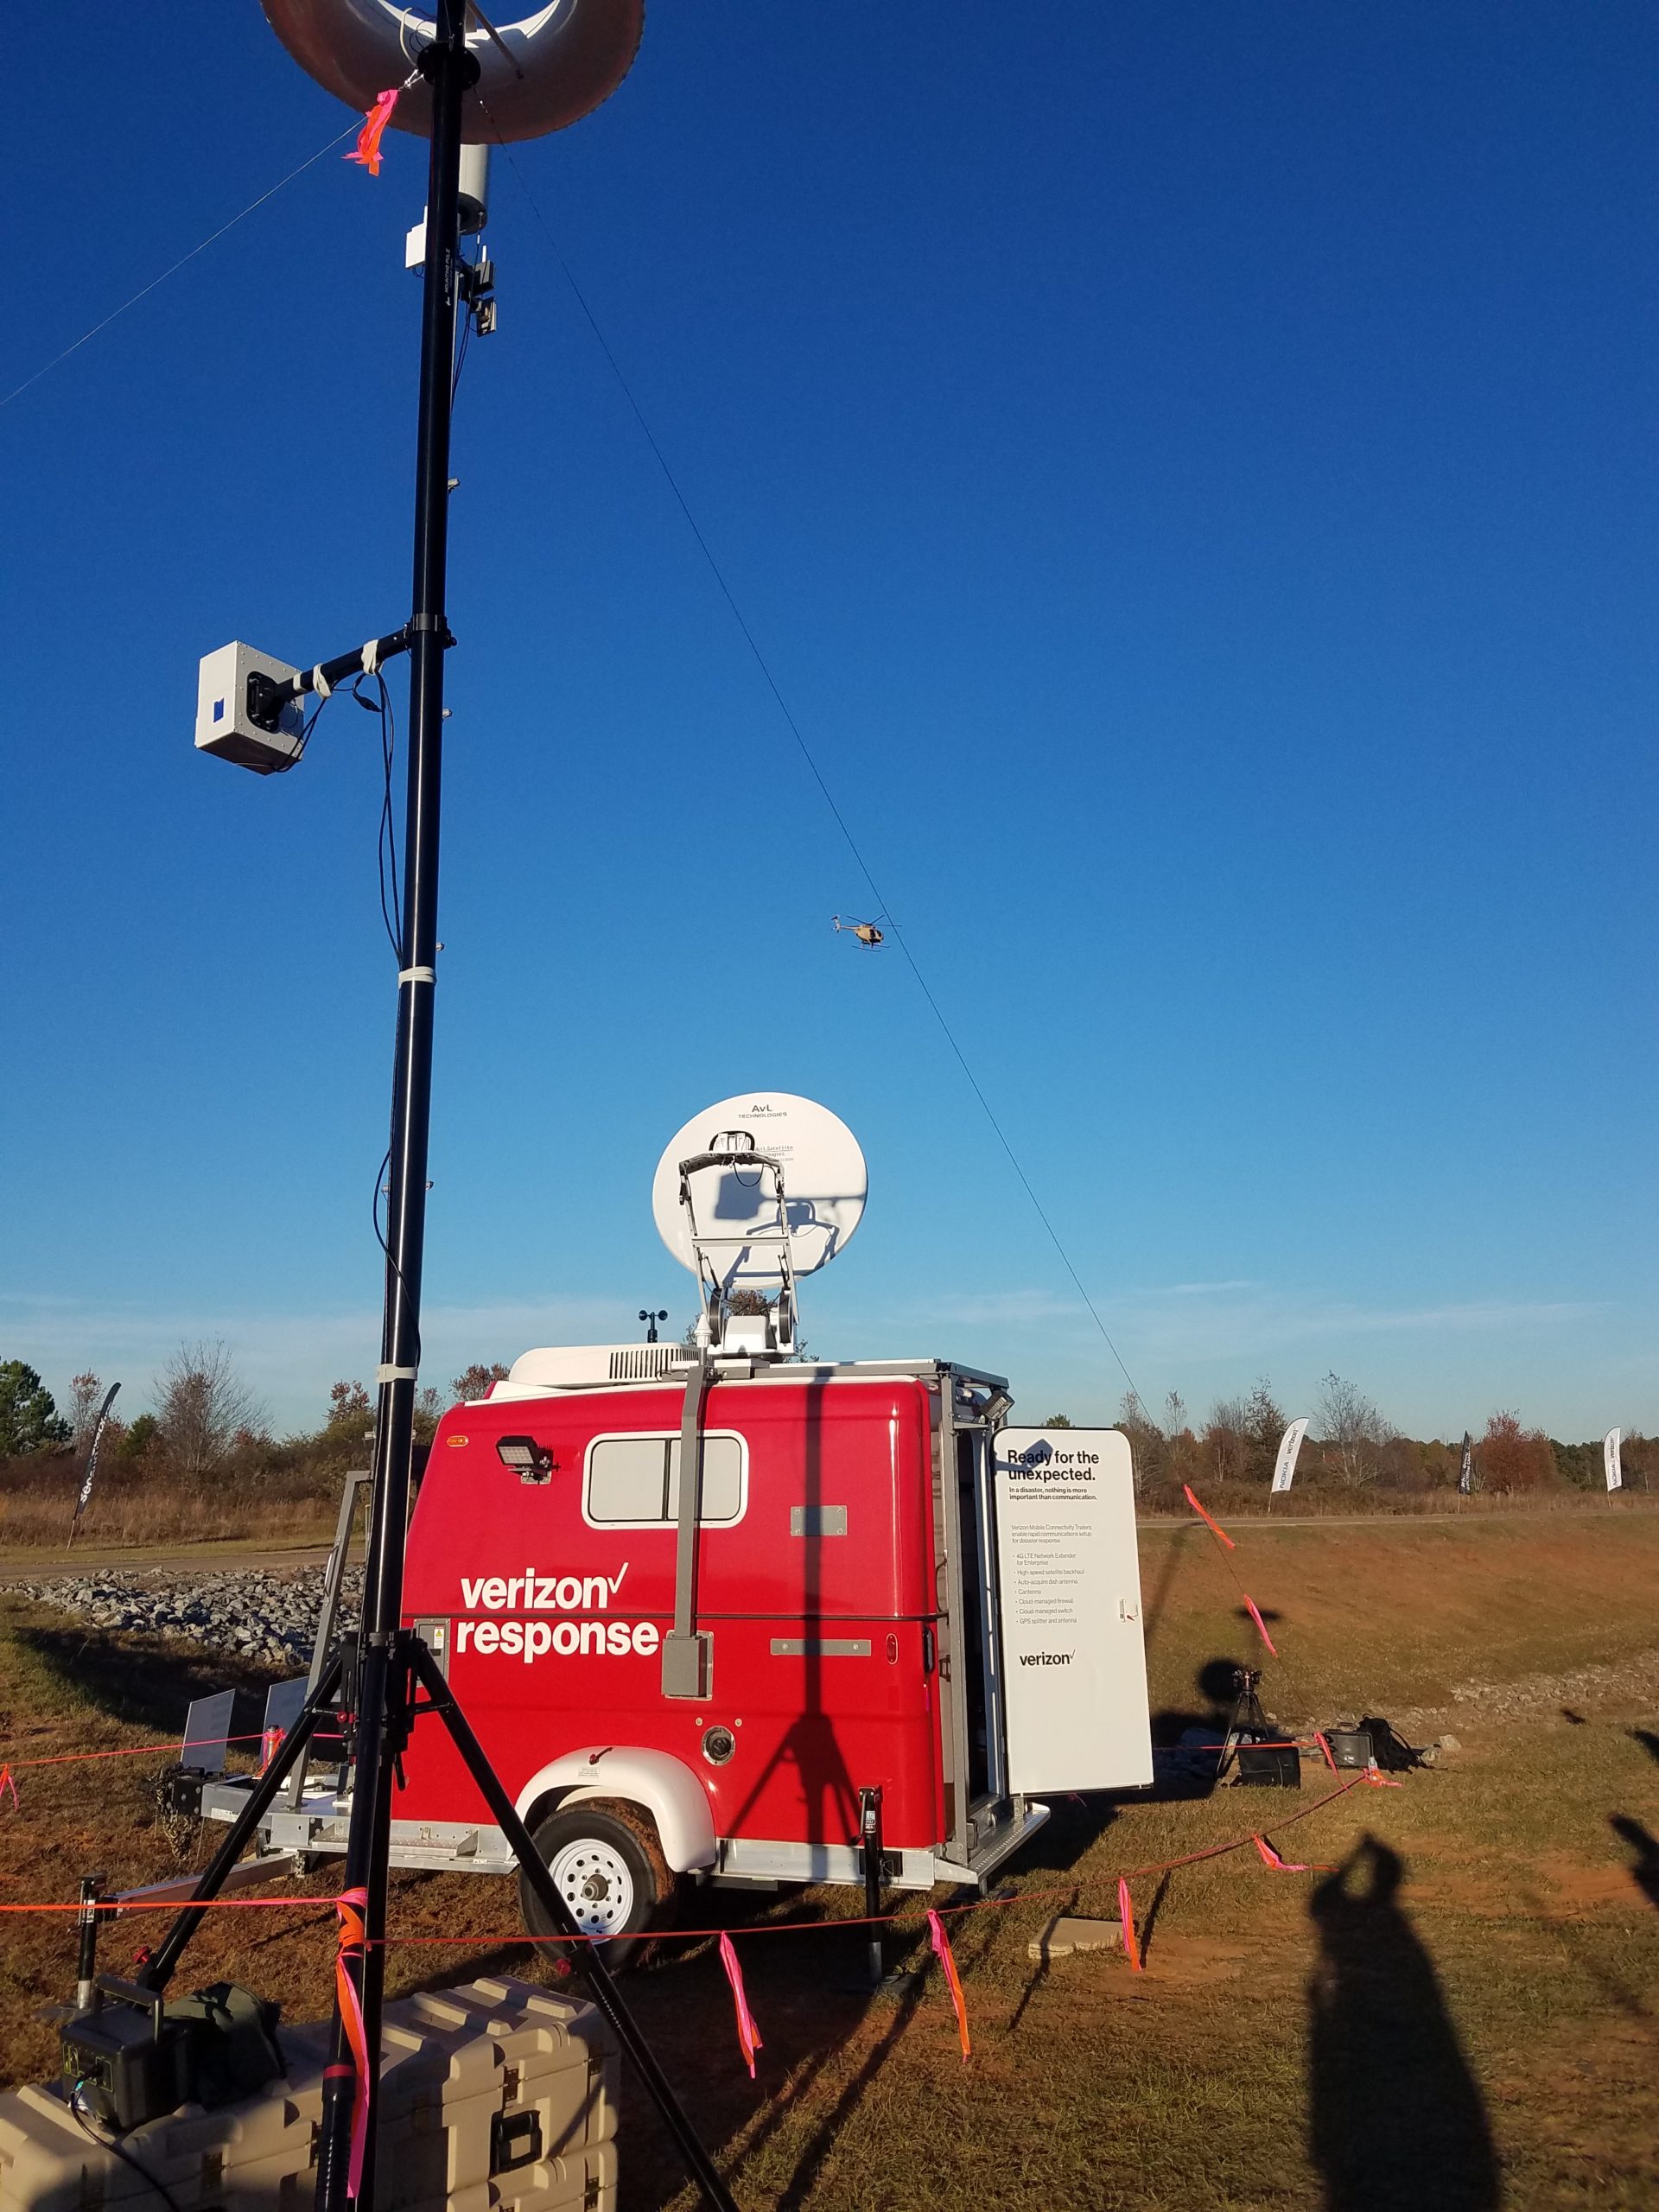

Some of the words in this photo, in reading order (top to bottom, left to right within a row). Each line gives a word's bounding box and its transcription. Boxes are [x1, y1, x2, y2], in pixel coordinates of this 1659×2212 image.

[751, 1103, 773, 1112] AvL
[1286, 1428, 1299, 1455] verizon
[1007, 1449, 1052, 1466] Ready
[1054, 1450, 1074, 1464] for
[1077, 1450, 1100, 1464] the
[1008, 1467, 1096, 1484] unexpected.
[1280, 1461, 1290, 1489] NOKIA
[460, 1567, 608, 1610] verizon
[456, 1621, 660, 1664] response
[1019, 1651, 1071, 1667] verizon
